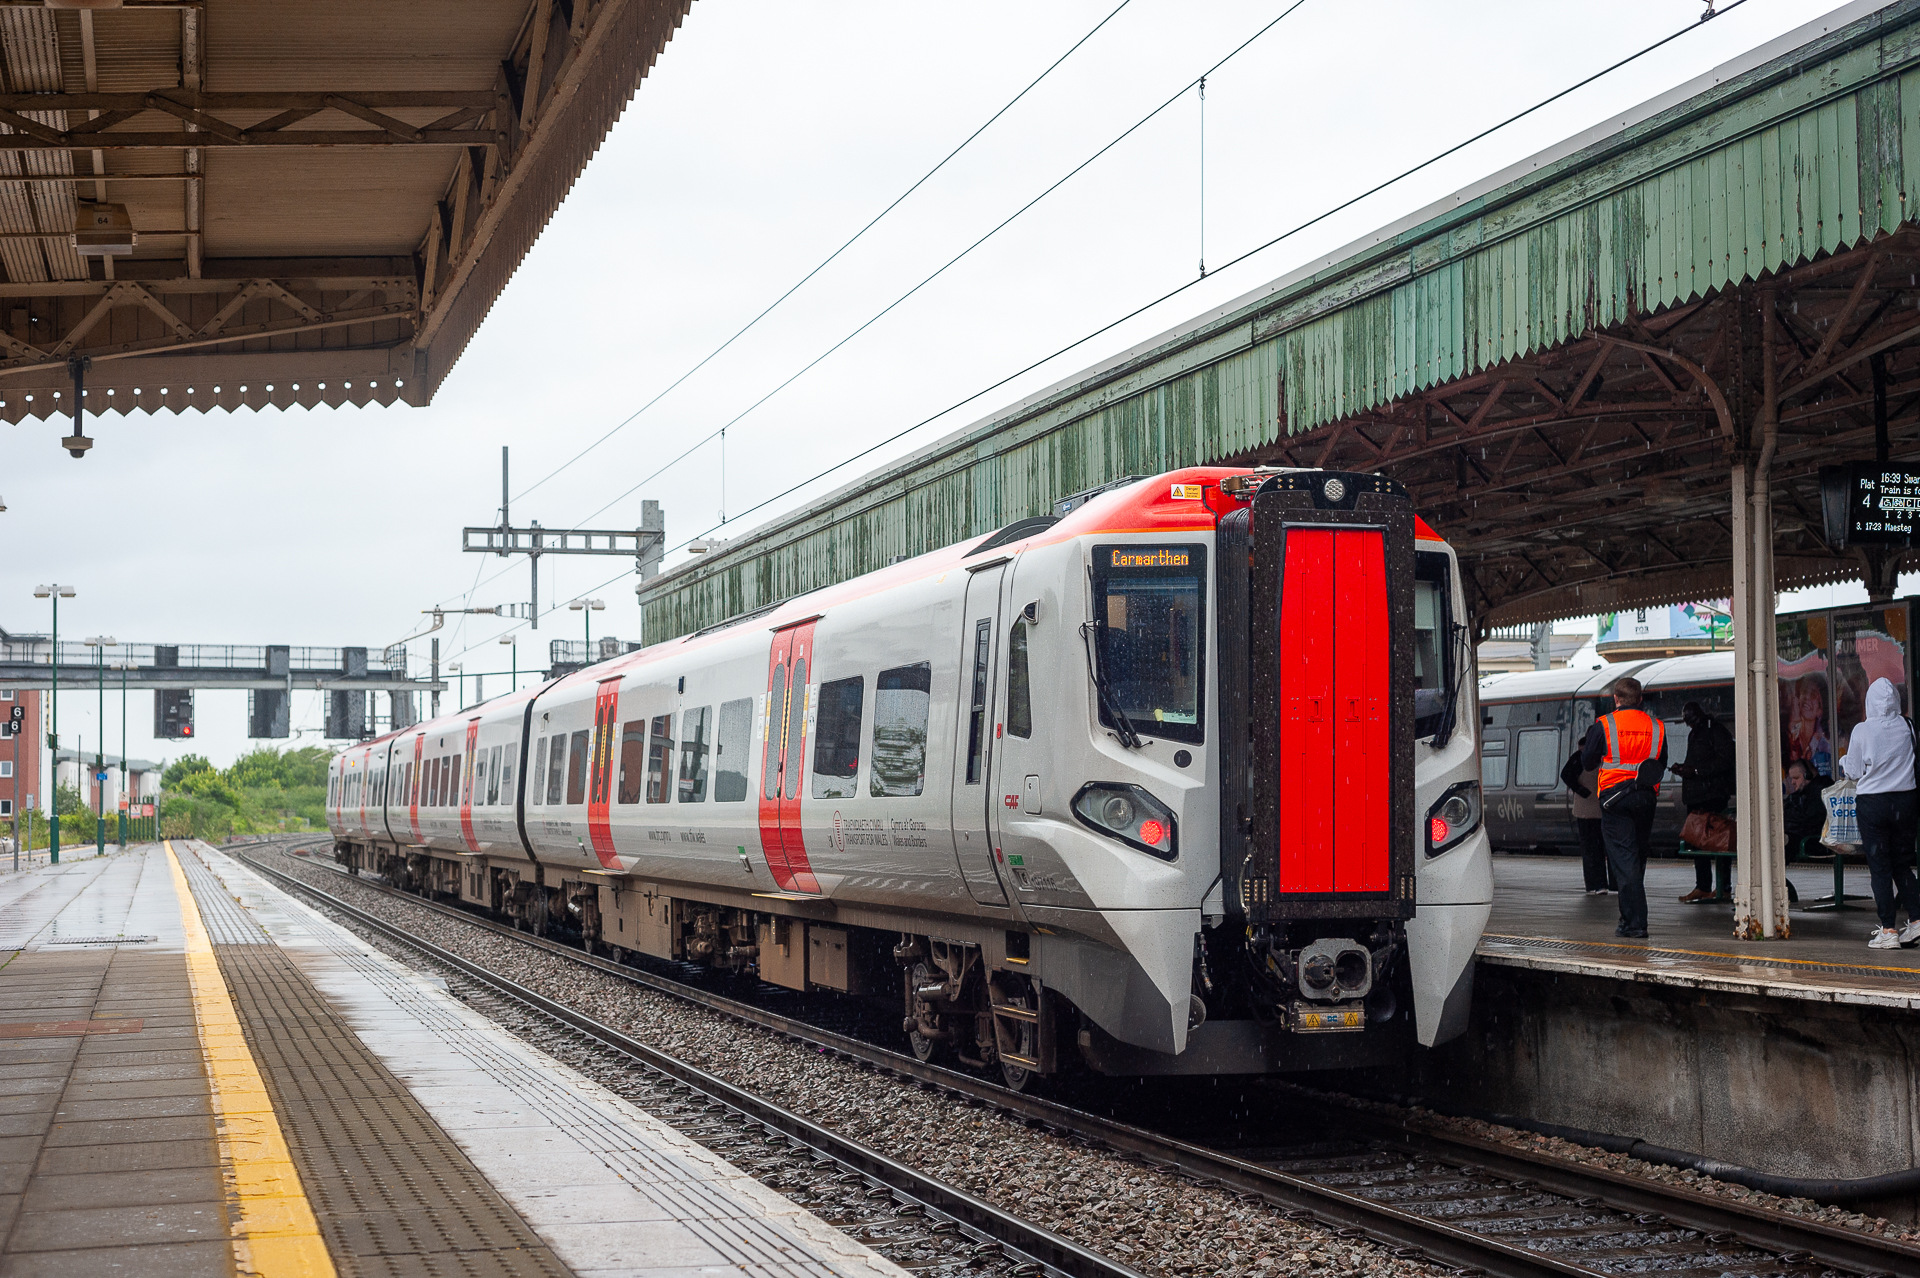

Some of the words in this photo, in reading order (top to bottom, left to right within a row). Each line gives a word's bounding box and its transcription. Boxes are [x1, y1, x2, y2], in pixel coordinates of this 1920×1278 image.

[1881, 473, 1901, 484] 16:39
[1860, 479, 1875, 490] Plat
[1880, 485, 1901, 494] Train
[1903, 486, 1912, 495] is
[1862, 493, 1871, 508] 4
[1865, 522, 1882, 531] 17:23
[1884, 522, 1912, 534] Maesteg
[1112, 549, 1189, 566] Carmarthen
[13, 707, 22, 717] 6
[11, 720, 19, 731] 6
[1497, 794, 1524, 823] GWR
